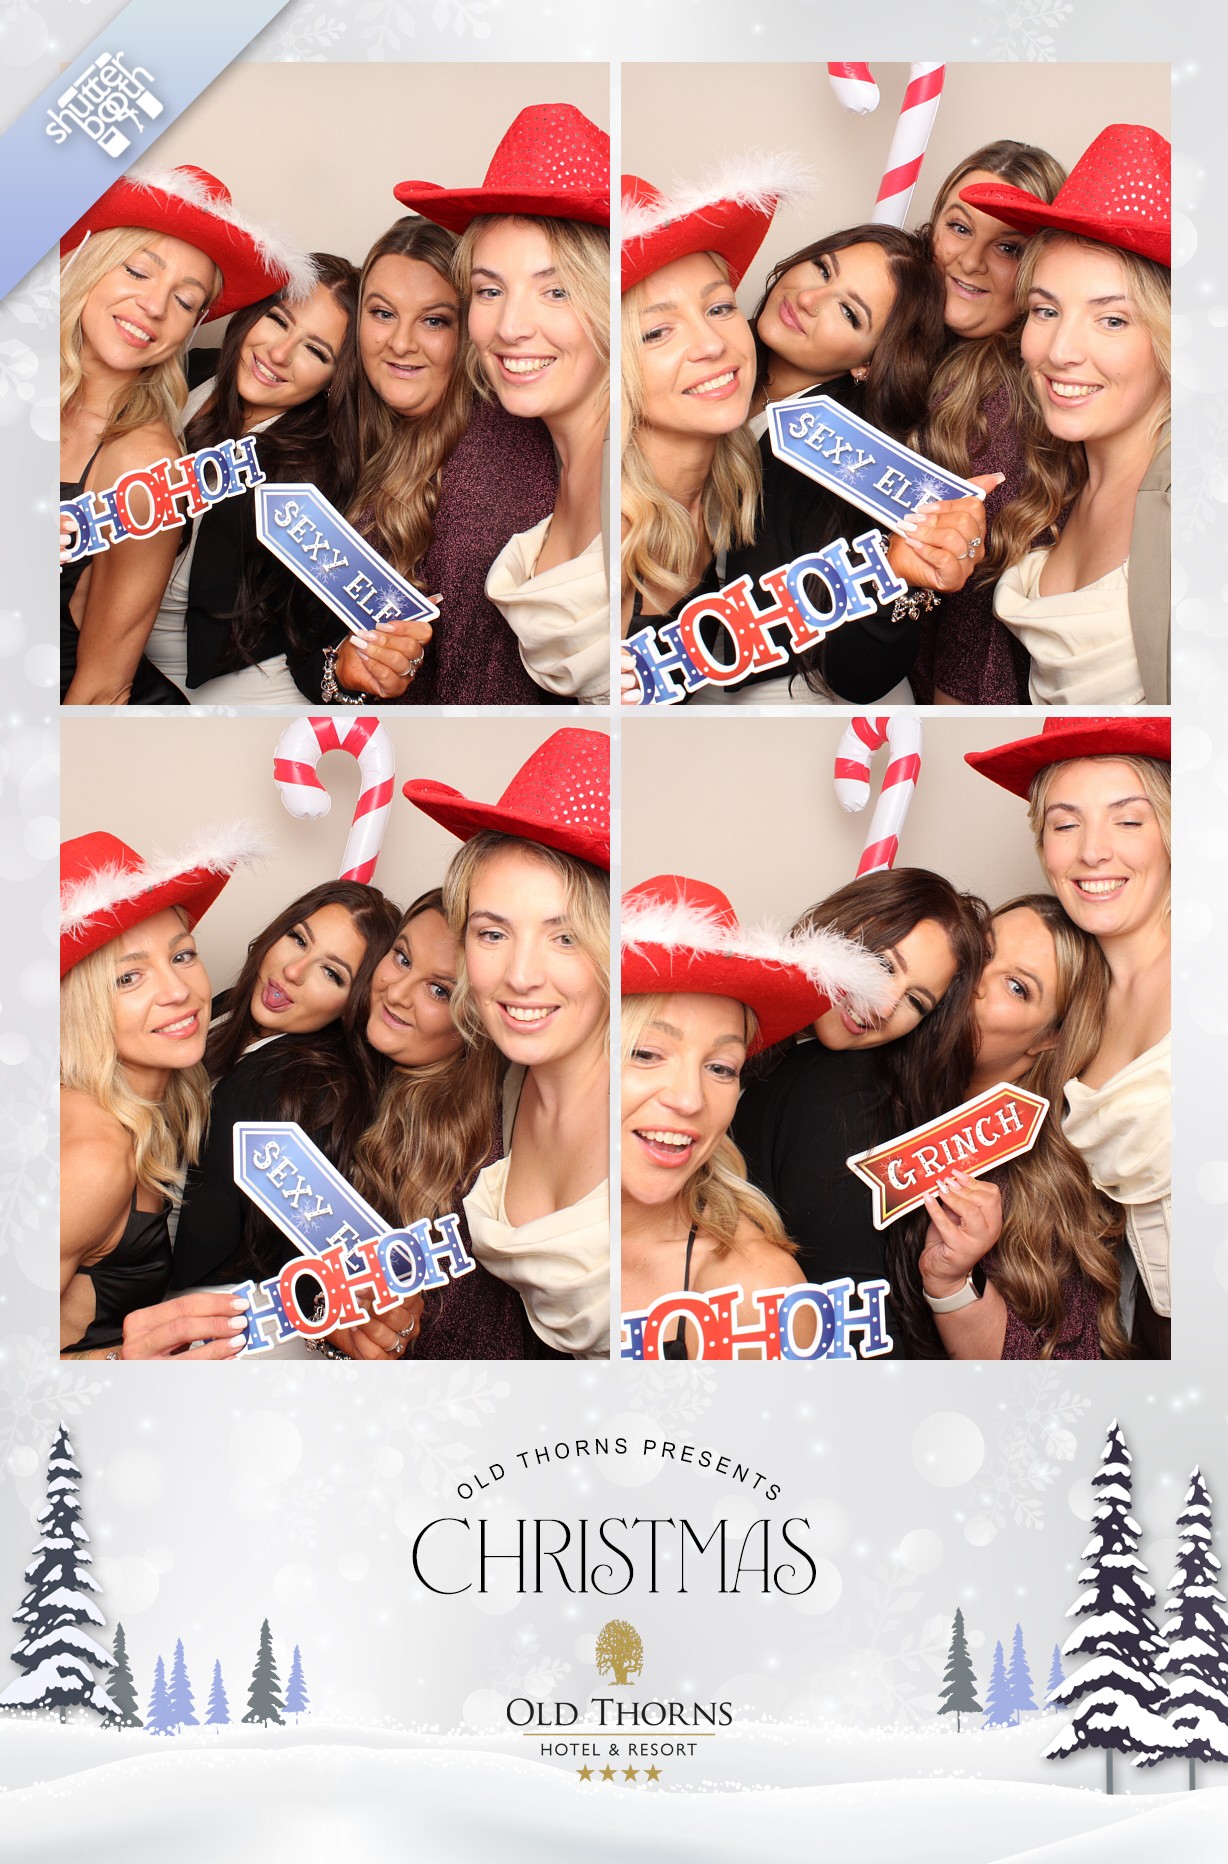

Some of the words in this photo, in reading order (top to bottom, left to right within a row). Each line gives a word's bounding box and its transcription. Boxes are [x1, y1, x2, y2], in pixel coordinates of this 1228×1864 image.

[789, 412, 876, 474] SEXY
[274, 500, 349, 573] SEXY
[343, 570, 401, 623] ELF
[253, 1141, 333, 1221] SEXY
[887, 1101, 1024, 1190] GRINCH
